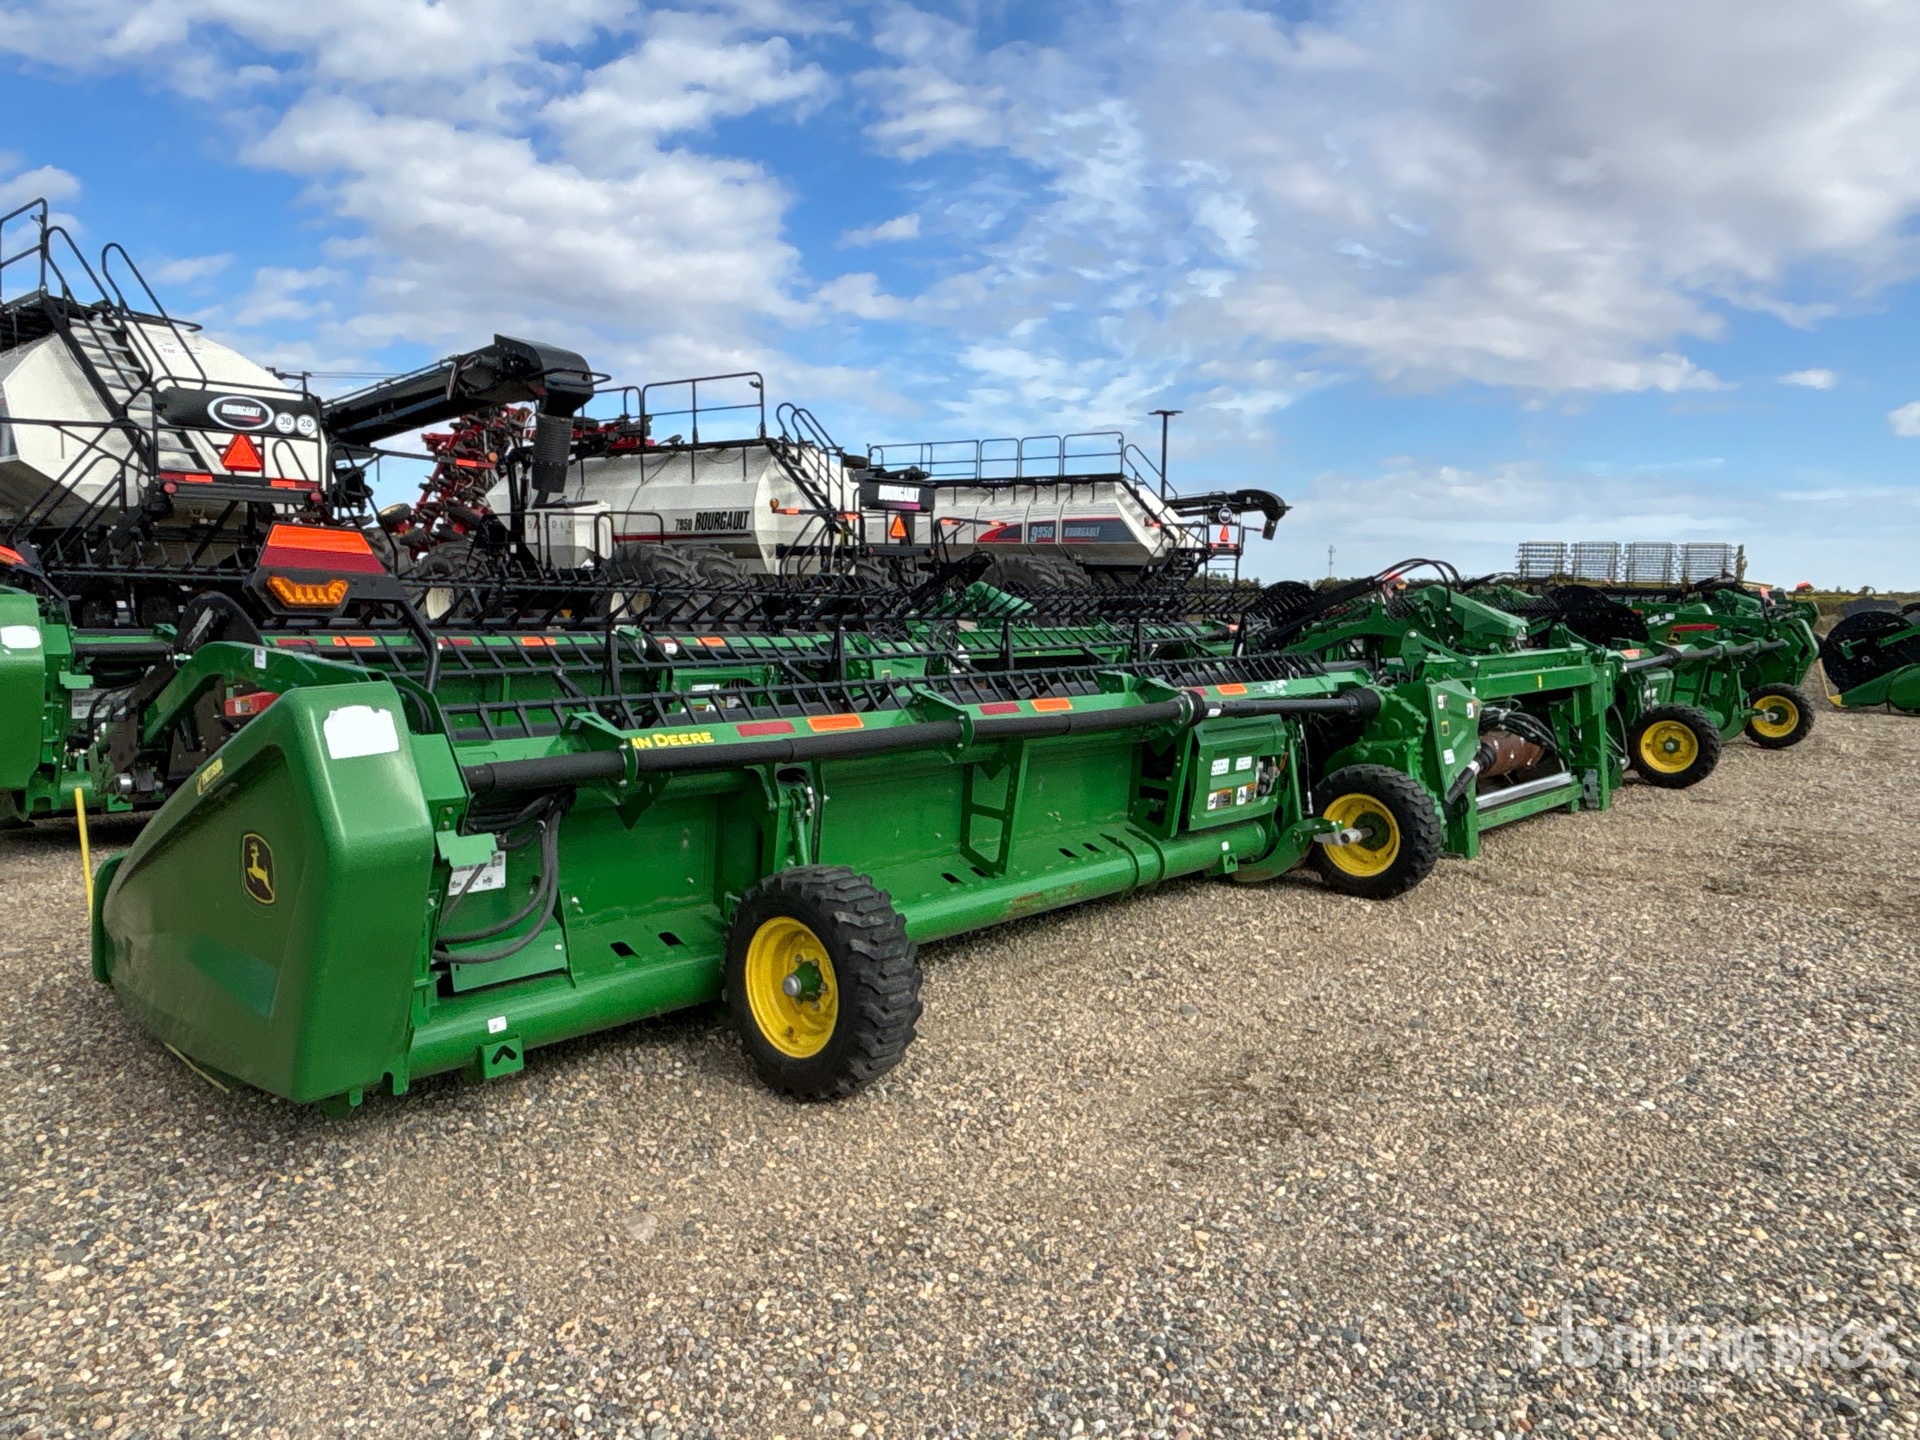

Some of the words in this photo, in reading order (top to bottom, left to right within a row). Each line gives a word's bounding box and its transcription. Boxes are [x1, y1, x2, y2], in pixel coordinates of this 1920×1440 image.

[280, 416, 292, 426] 30
[300, 418, 312, 428] 20
[675, 518, 693, 532] 7950
[694, 510, 751, 531] BOURGAULT
[1030, 525, 1054, 542] 9950
[652, 732, 715, 748] DEERE
